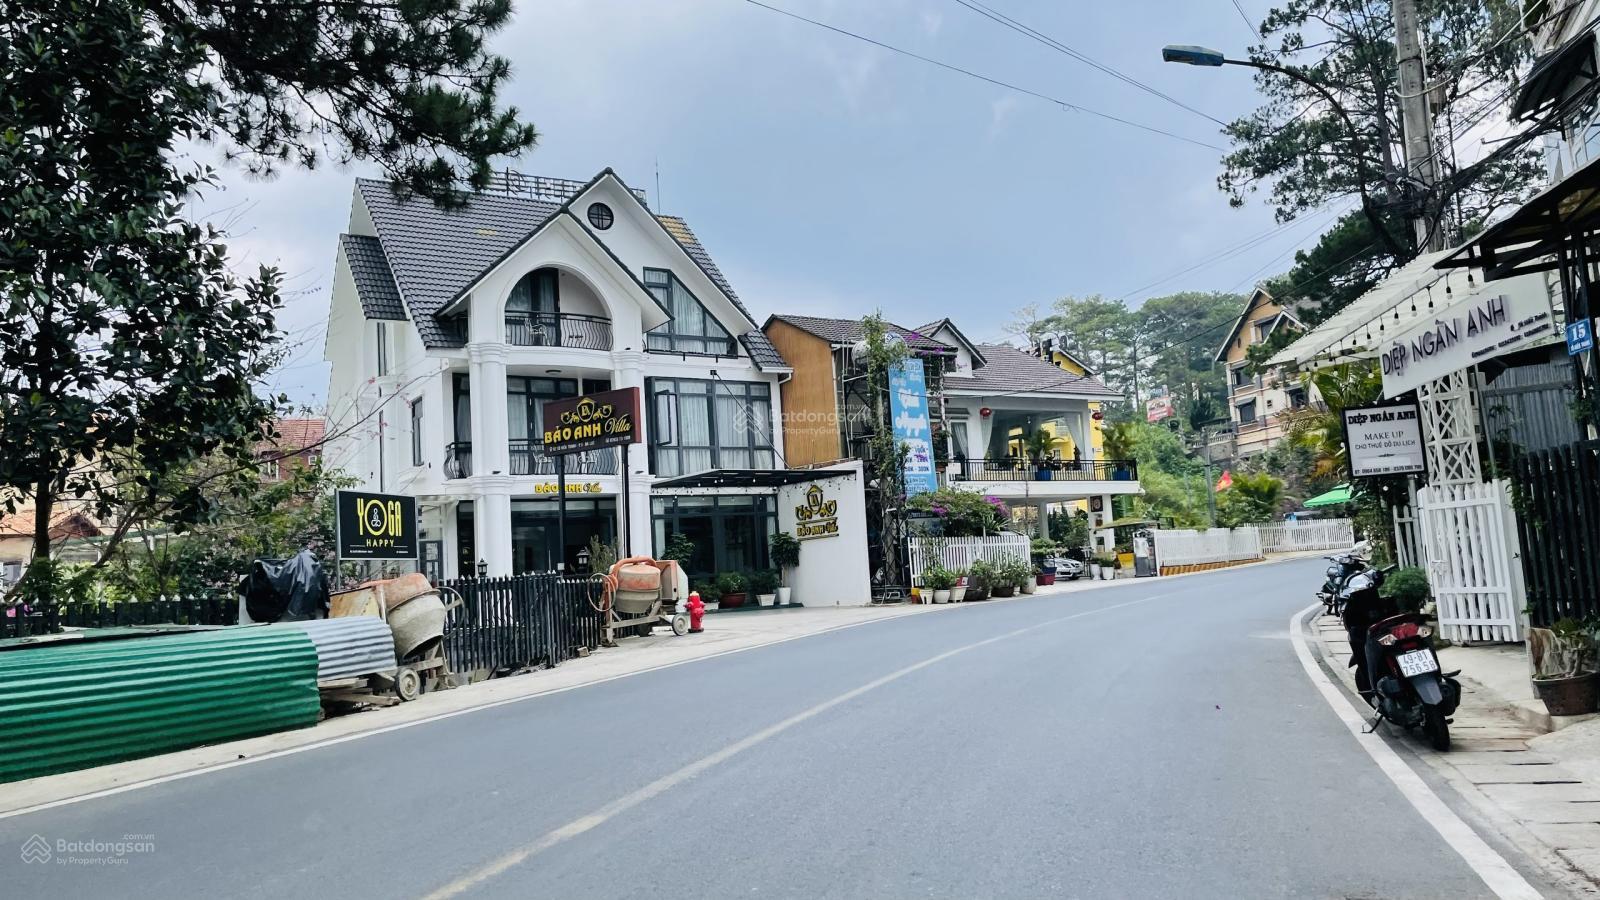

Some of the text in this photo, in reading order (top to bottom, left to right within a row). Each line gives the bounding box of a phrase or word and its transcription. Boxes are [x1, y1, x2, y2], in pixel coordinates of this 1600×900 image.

[1382, 341, 1407, 376] DIỆP
[1411, 318, 1459, 362] NGÂN
[1467, 295, 1507, 338] ANH
[1572, 323, 1586, 342] 15
[1348, 413, 1368, 426] DIỆP
[1397, 411, 1416, 420] ANH
[544, 425, 572, 444] BẢO
[574, 423, 601, 440] ANH
[605, 414, 632, 434] Villa
[1364, 432, 1390, 440] MAKE
[565, 483, 583, 492] NH
[357, 498, 402, 537] YOGA
[366, 538, 394, 547] HAPPY
